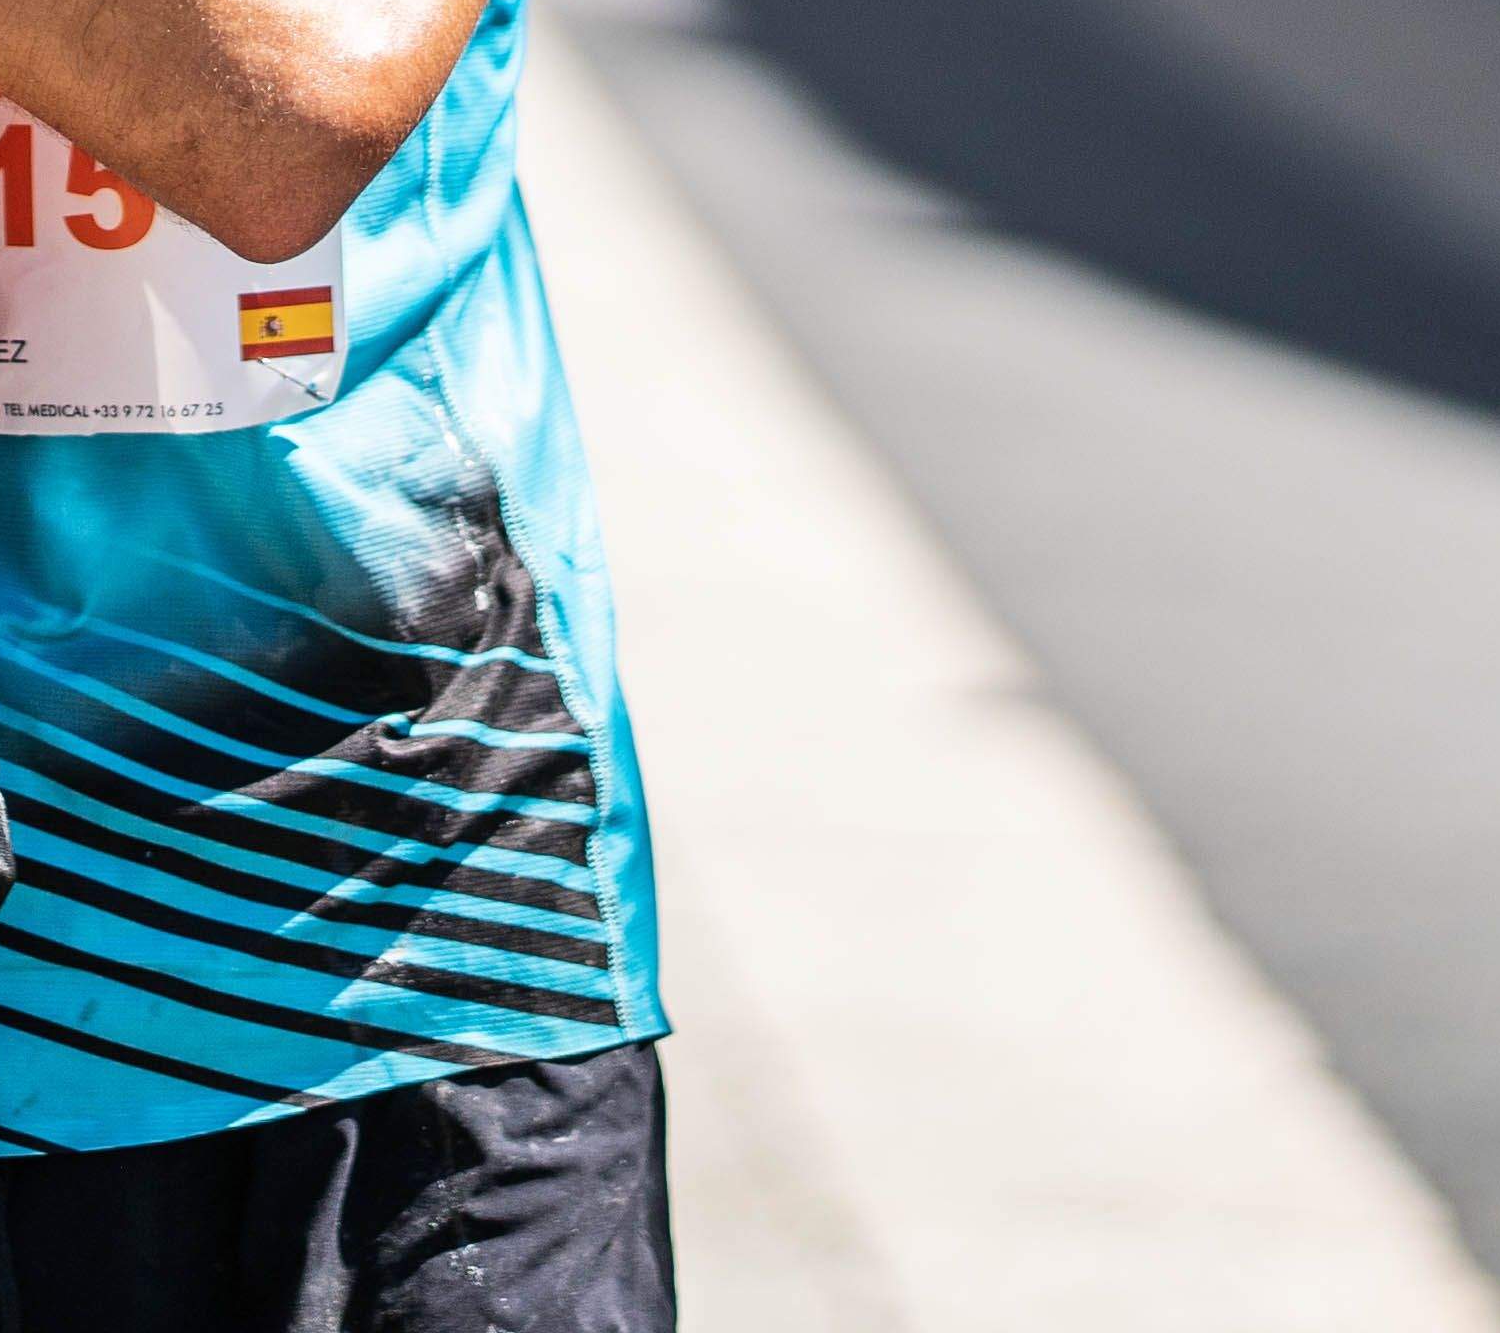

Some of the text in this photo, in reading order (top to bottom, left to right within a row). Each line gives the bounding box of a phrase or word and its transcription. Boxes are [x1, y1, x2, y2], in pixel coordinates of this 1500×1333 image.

[3, 403, 25, 417] TEL
[27, 403, 89, 418] MEDICAL
[93, 404, 119, 418] +33
[122, 404, 132, 418] 9
[135, 404, 155, 419] 72
[160, 404, 177, 418] 16
[180, 403, 200, 418] 67
[204, 401, 225, 417] 25
